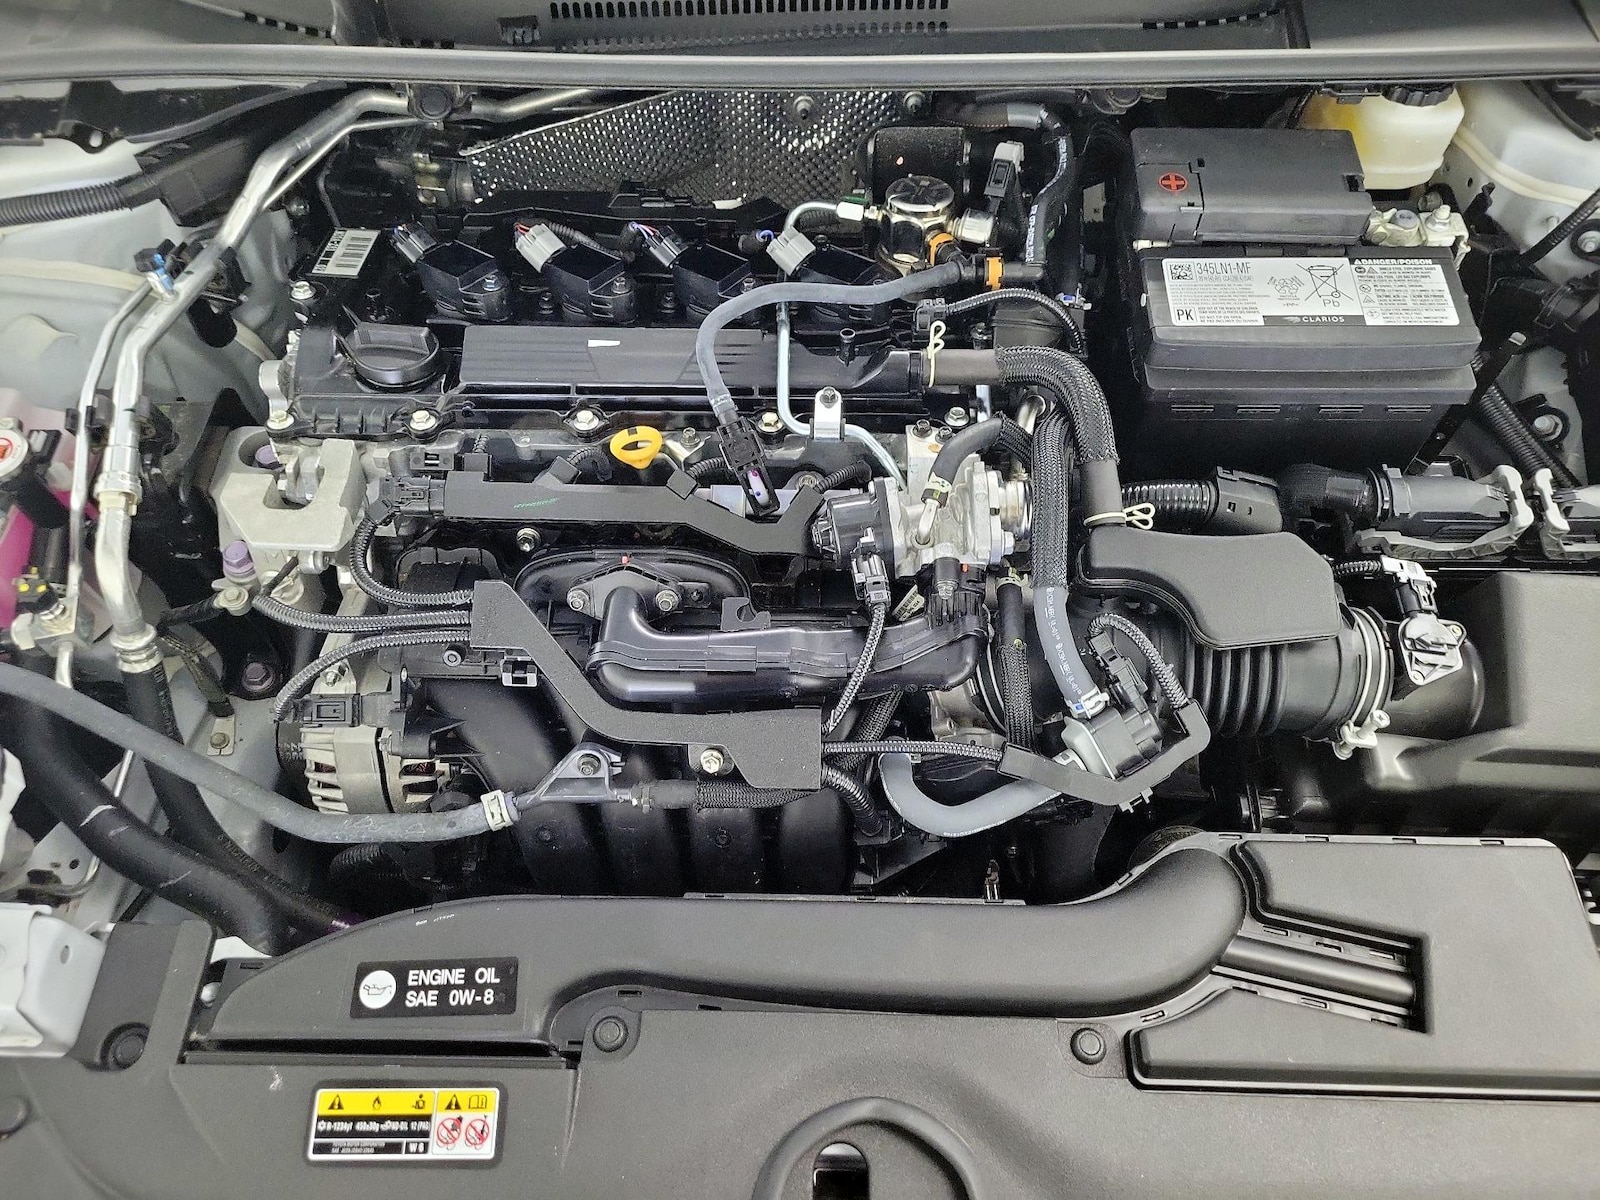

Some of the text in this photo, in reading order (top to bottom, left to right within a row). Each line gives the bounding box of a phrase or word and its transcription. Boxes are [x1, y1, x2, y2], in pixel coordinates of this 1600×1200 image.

[1196, 262, 1251, 275] 345LN1-MF
[1323, 299, 1340, 307] Pb
[1176, 309, 1194, 321] PK
[407, 967, 500, 986] ENGINE OIL
[405, 989, 494, 1007] SAE 0W-8
